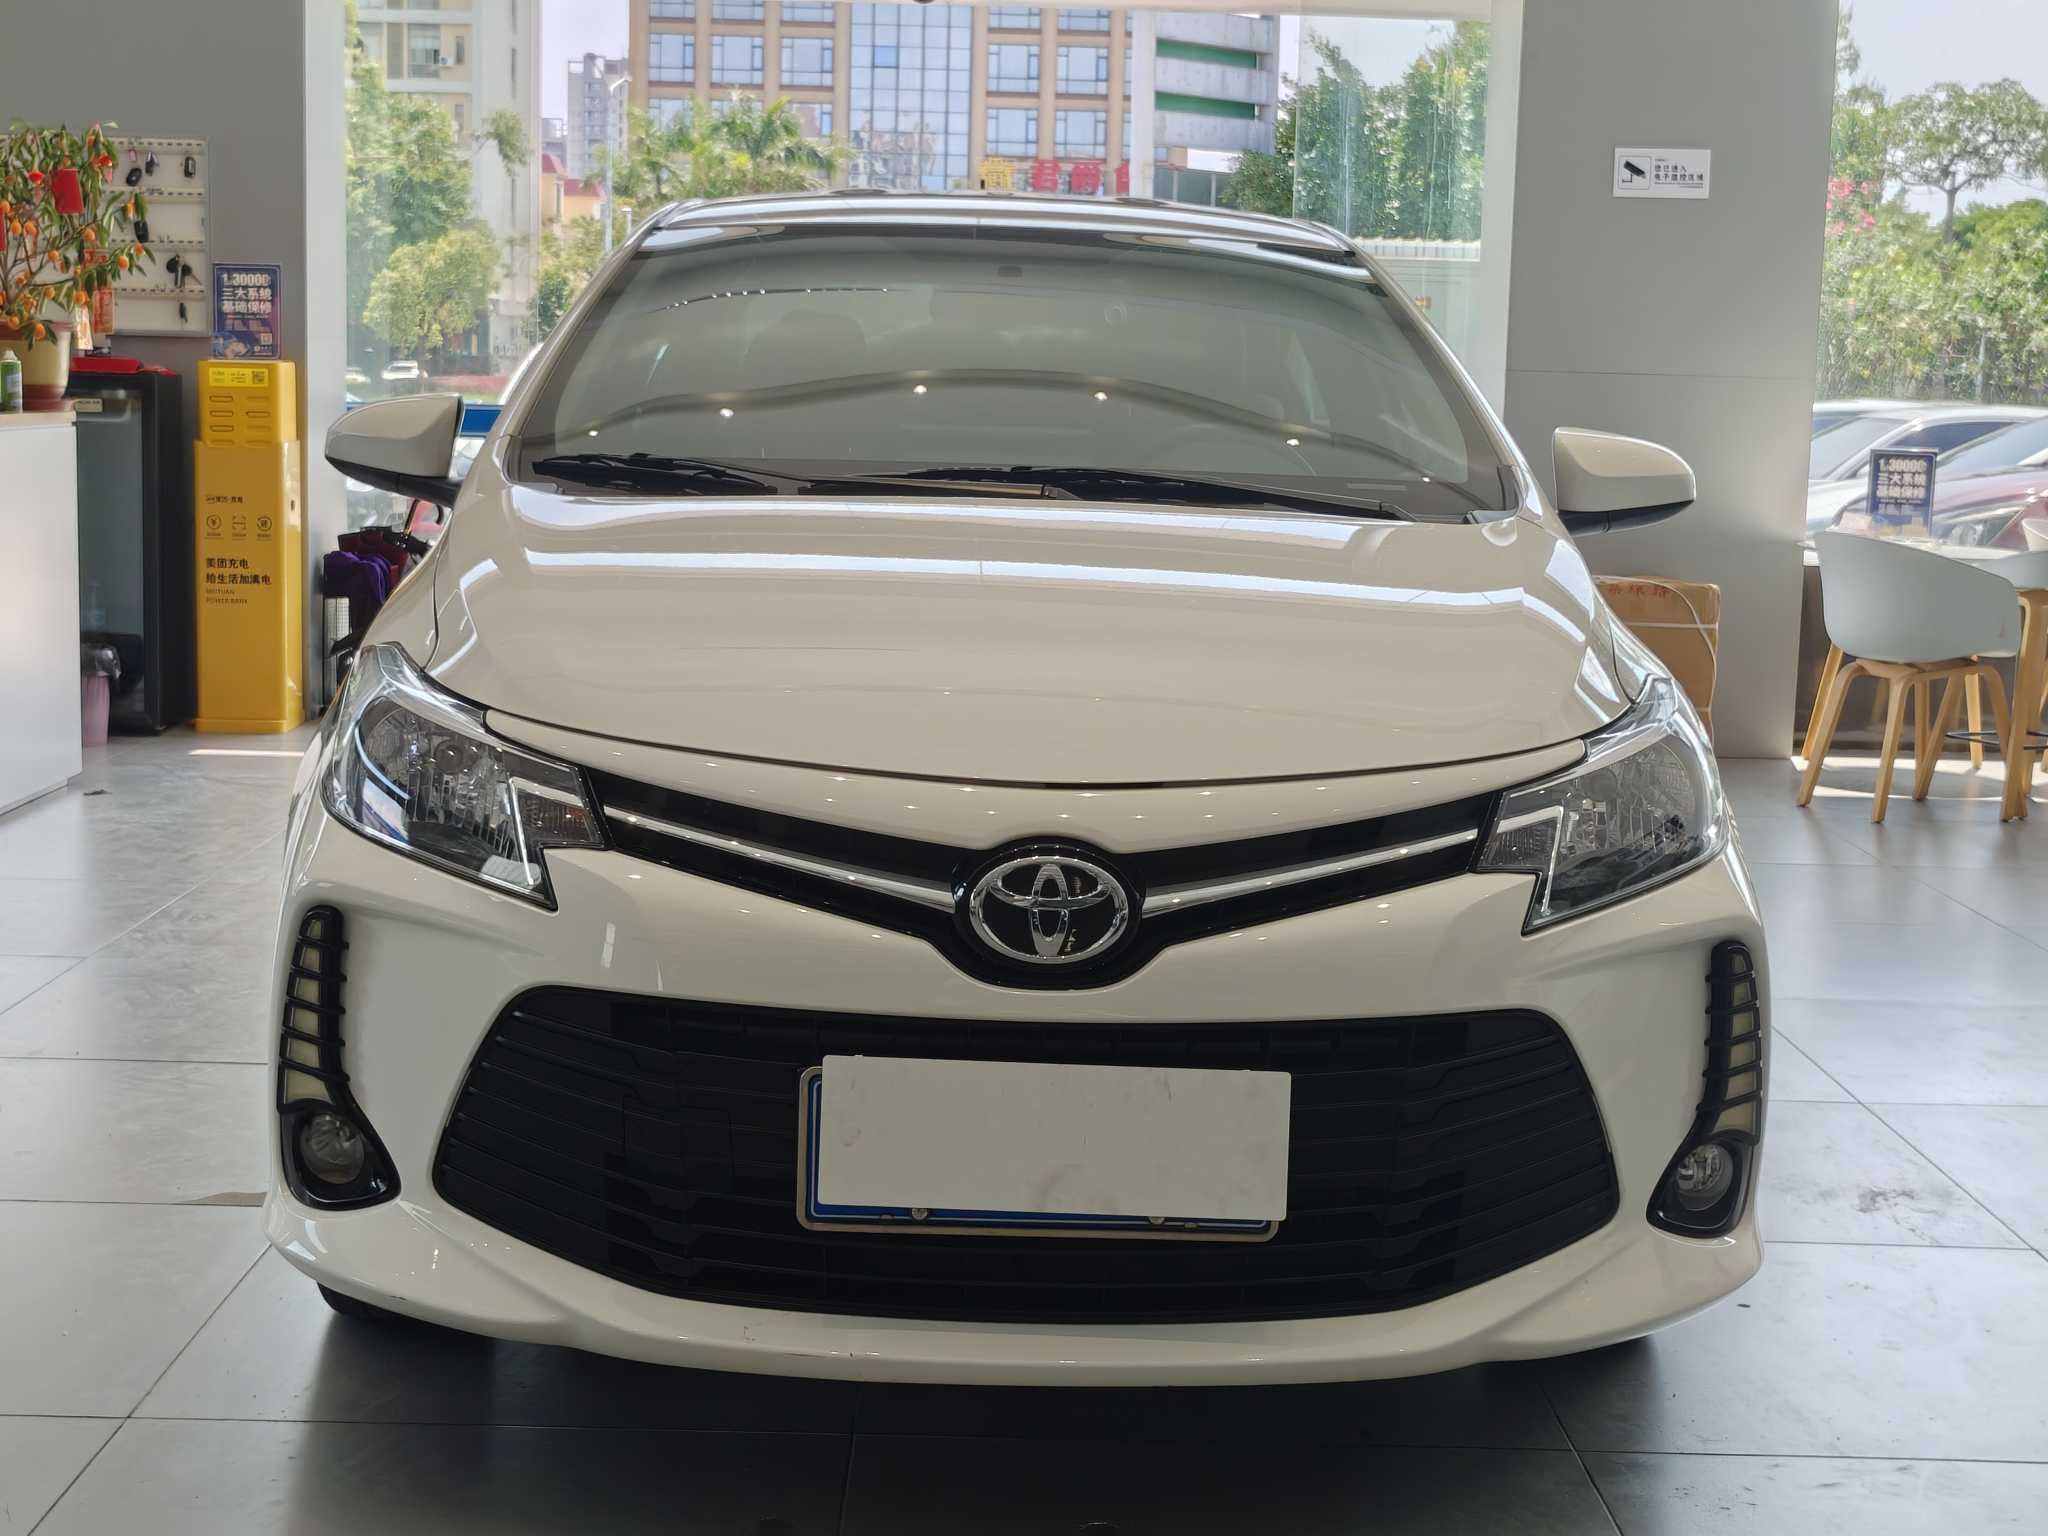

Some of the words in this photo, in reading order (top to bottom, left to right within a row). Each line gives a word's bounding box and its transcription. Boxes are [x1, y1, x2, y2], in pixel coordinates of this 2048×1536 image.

[222, 287, 273, 301] 三大系统
[206, 558, 249, 569] 美团充电
[206, 573, 272, 586] 给生活加满电
